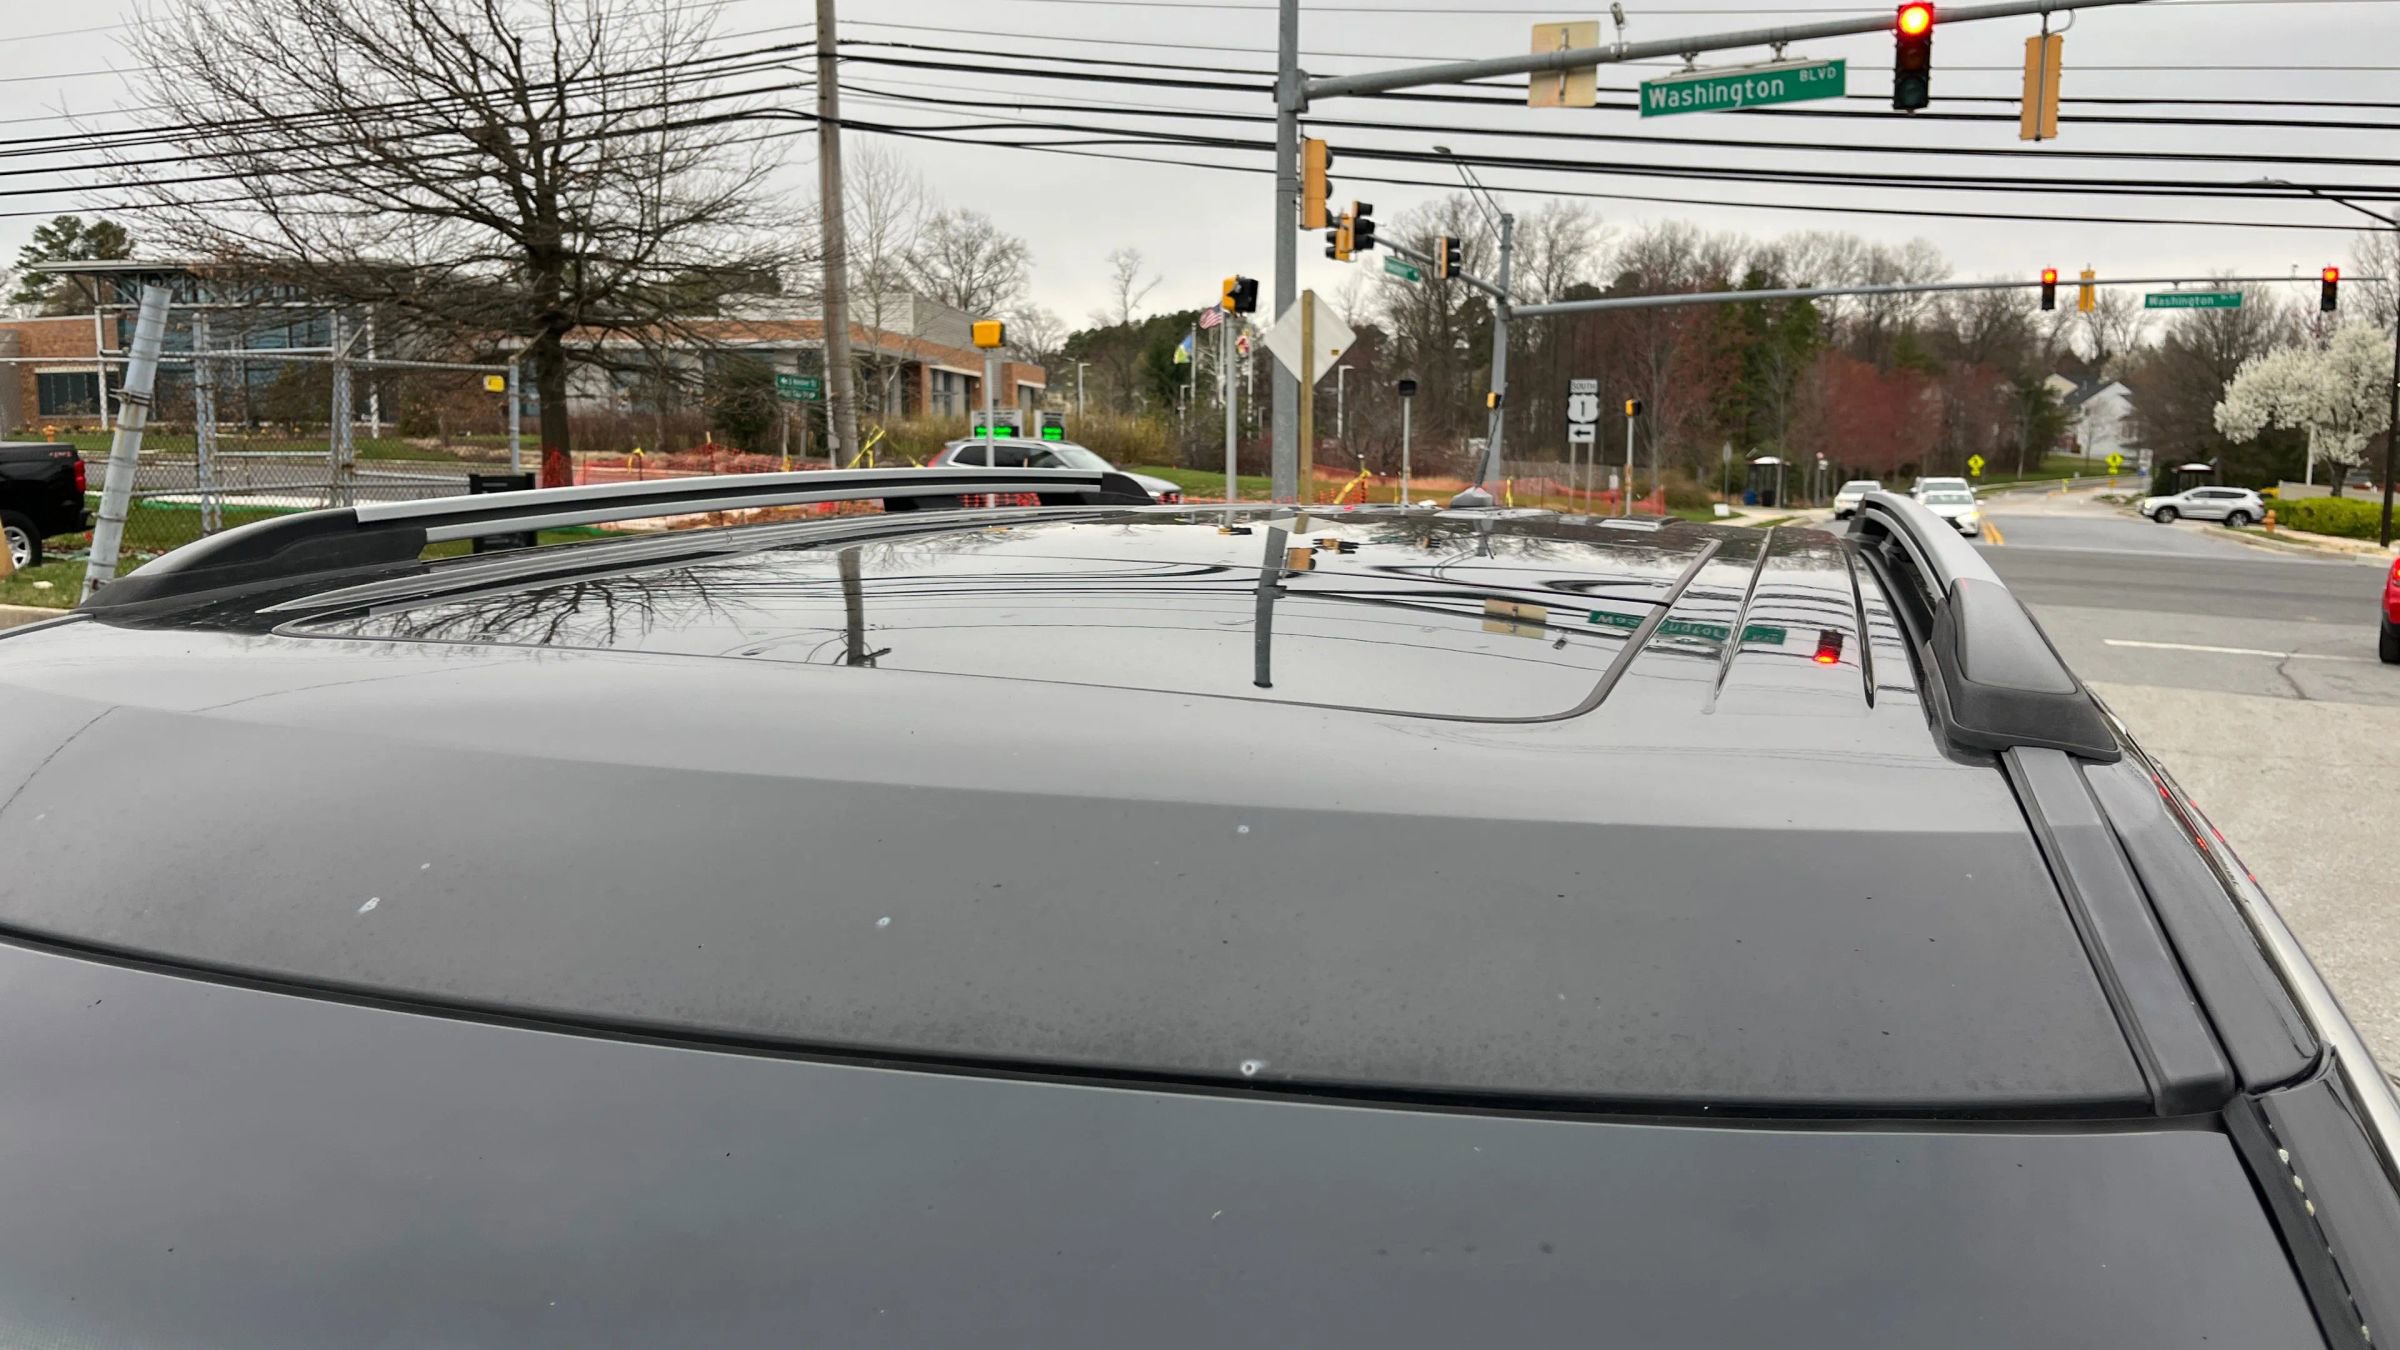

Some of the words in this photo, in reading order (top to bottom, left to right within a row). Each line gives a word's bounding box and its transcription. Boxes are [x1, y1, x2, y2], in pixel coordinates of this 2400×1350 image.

[1649, 79, 1785, 107] Washington
[1799, 66, 1837, 82] BLVD
[2149, 296, 2214, 308] Washington
[1571, 382, 1596, 391] SOUTH
